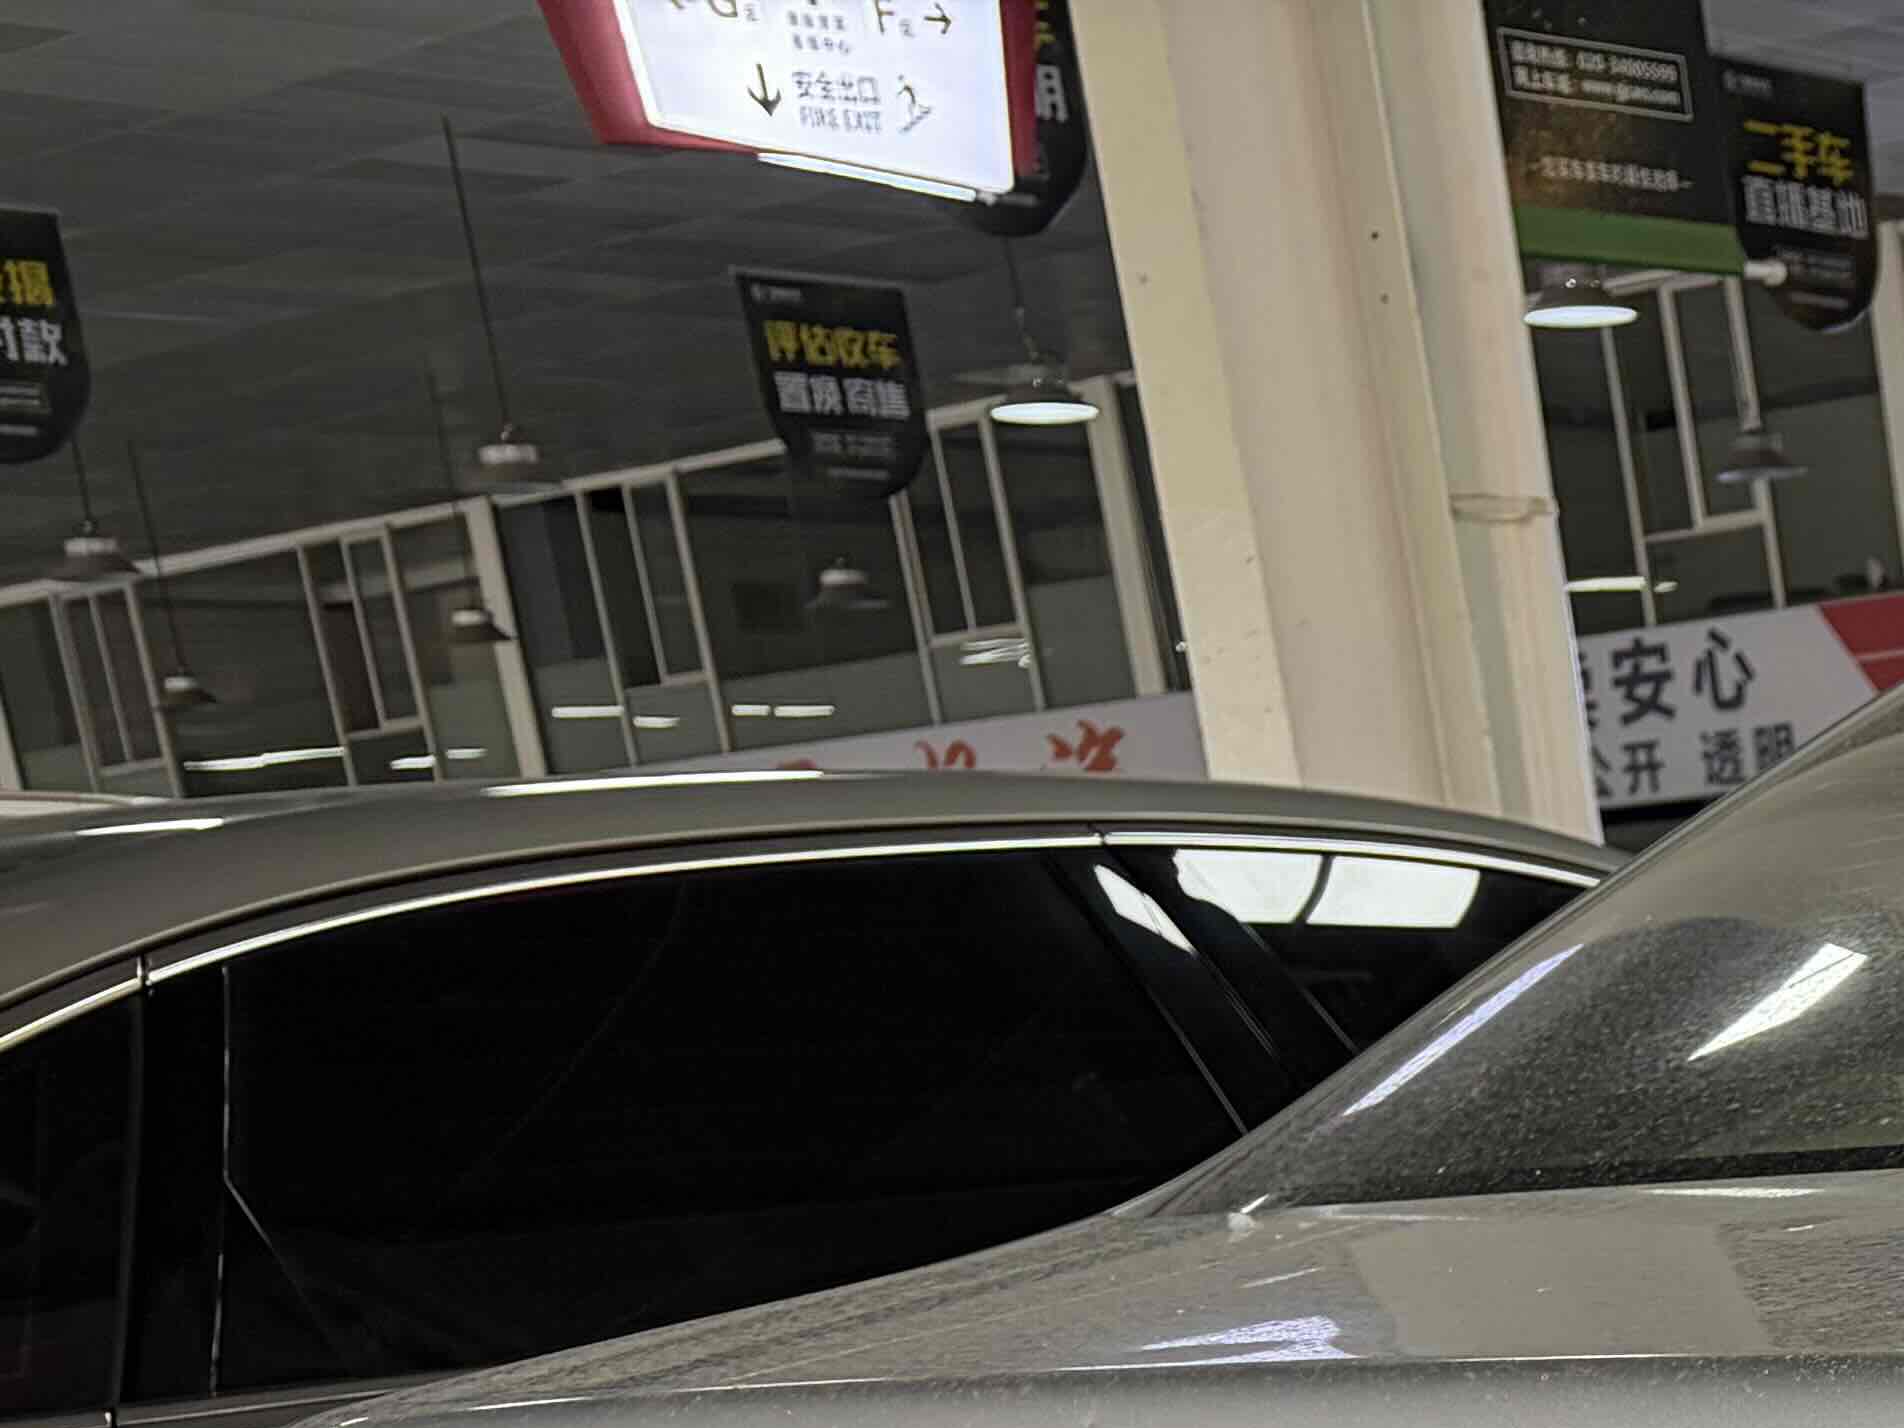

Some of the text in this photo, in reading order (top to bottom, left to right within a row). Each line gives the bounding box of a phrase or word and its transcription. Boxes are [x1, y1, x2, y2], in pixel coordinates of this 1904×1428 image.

[791, 70, 881, 105] 安全出口
[1743, 119, 1853, 188] 二手车
[1578, 627, 1756, 729] 安心
[1699, 721, 1797, 786] 透明
